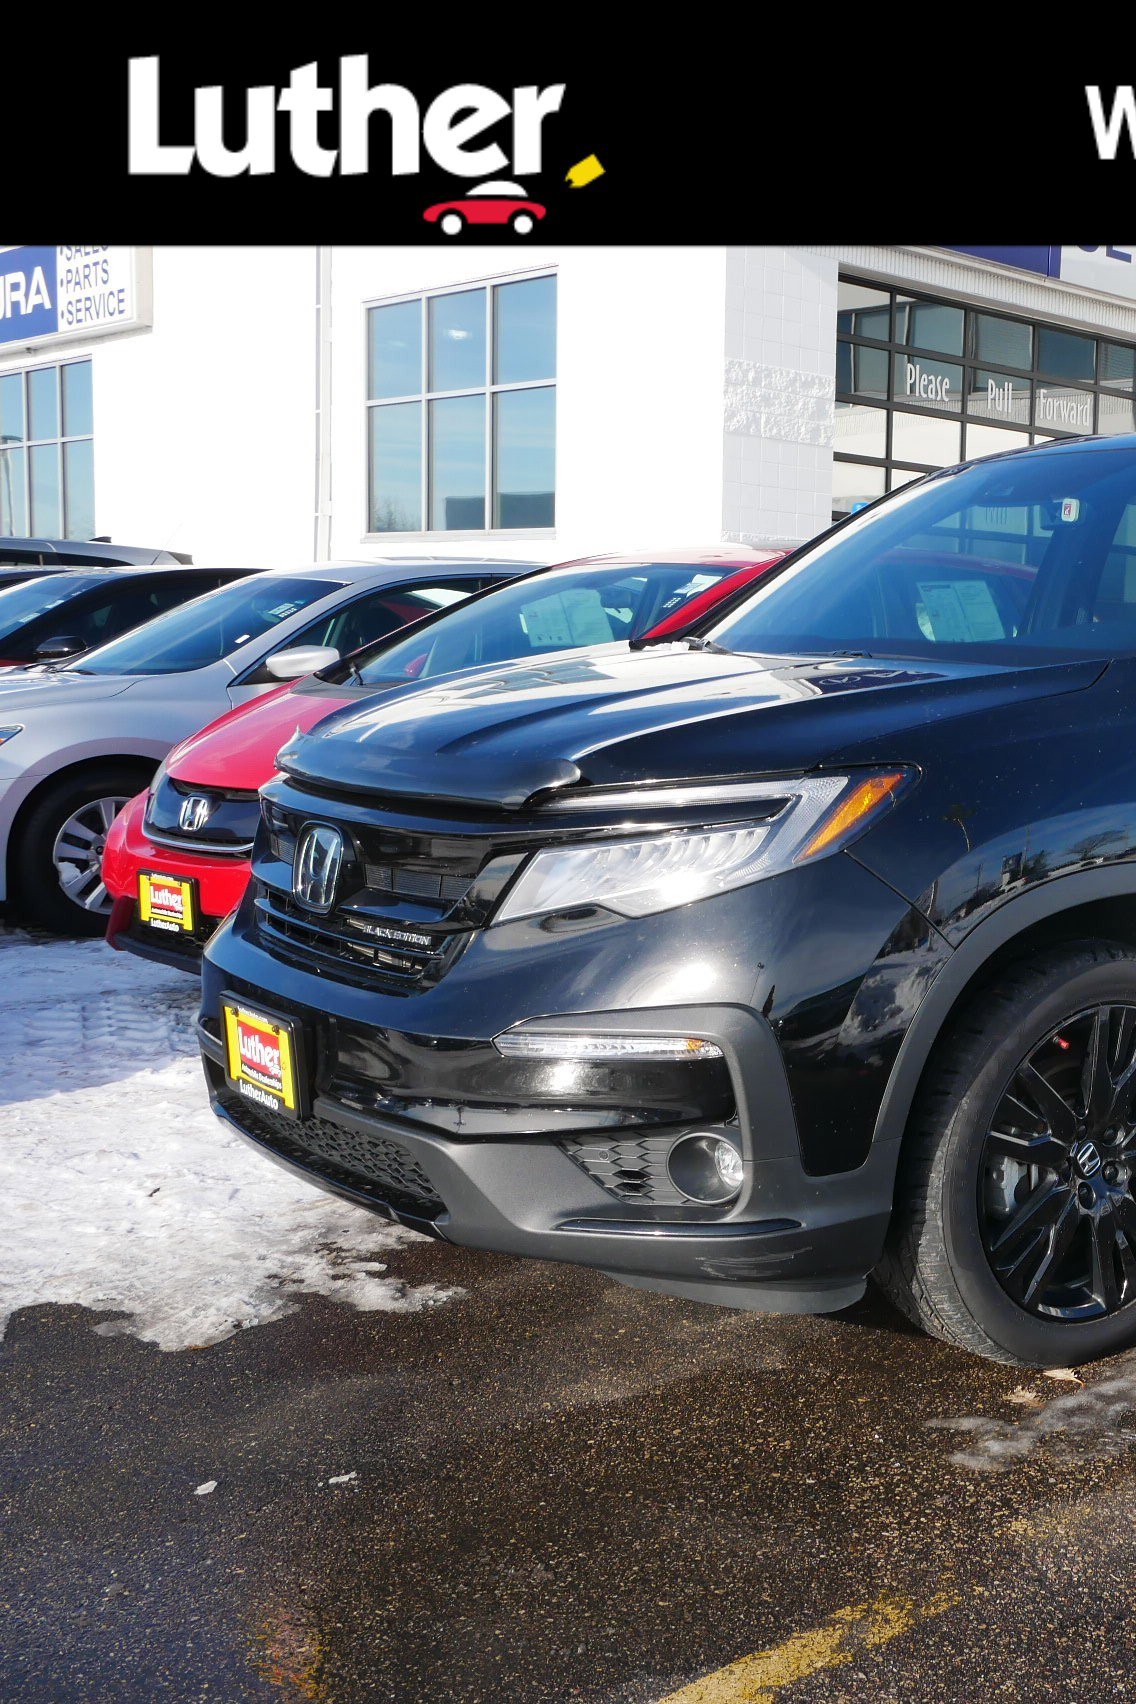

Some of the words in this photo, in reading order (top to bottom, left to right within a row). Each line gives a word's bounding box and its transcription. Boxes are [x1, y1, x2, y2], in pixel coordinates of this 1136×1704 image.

[65, 246, 109, 261] SAL
[66, 259, 109, 294] PARTS
[66, 288, 126, 326] SERVICE
[906, 363, 950, 402] Please
[988, 378, 1013, 413] Pull
[1039, 388, 1091, 427] Forward
[150, 885, 183, 908] Luther
[363, 924, 392, 938] BLACK
[393, 931, 431, 945] EDITION
[238, 1026, 280, 1068] Luther
[239, 1079, 279, 1110] LutherAuto
